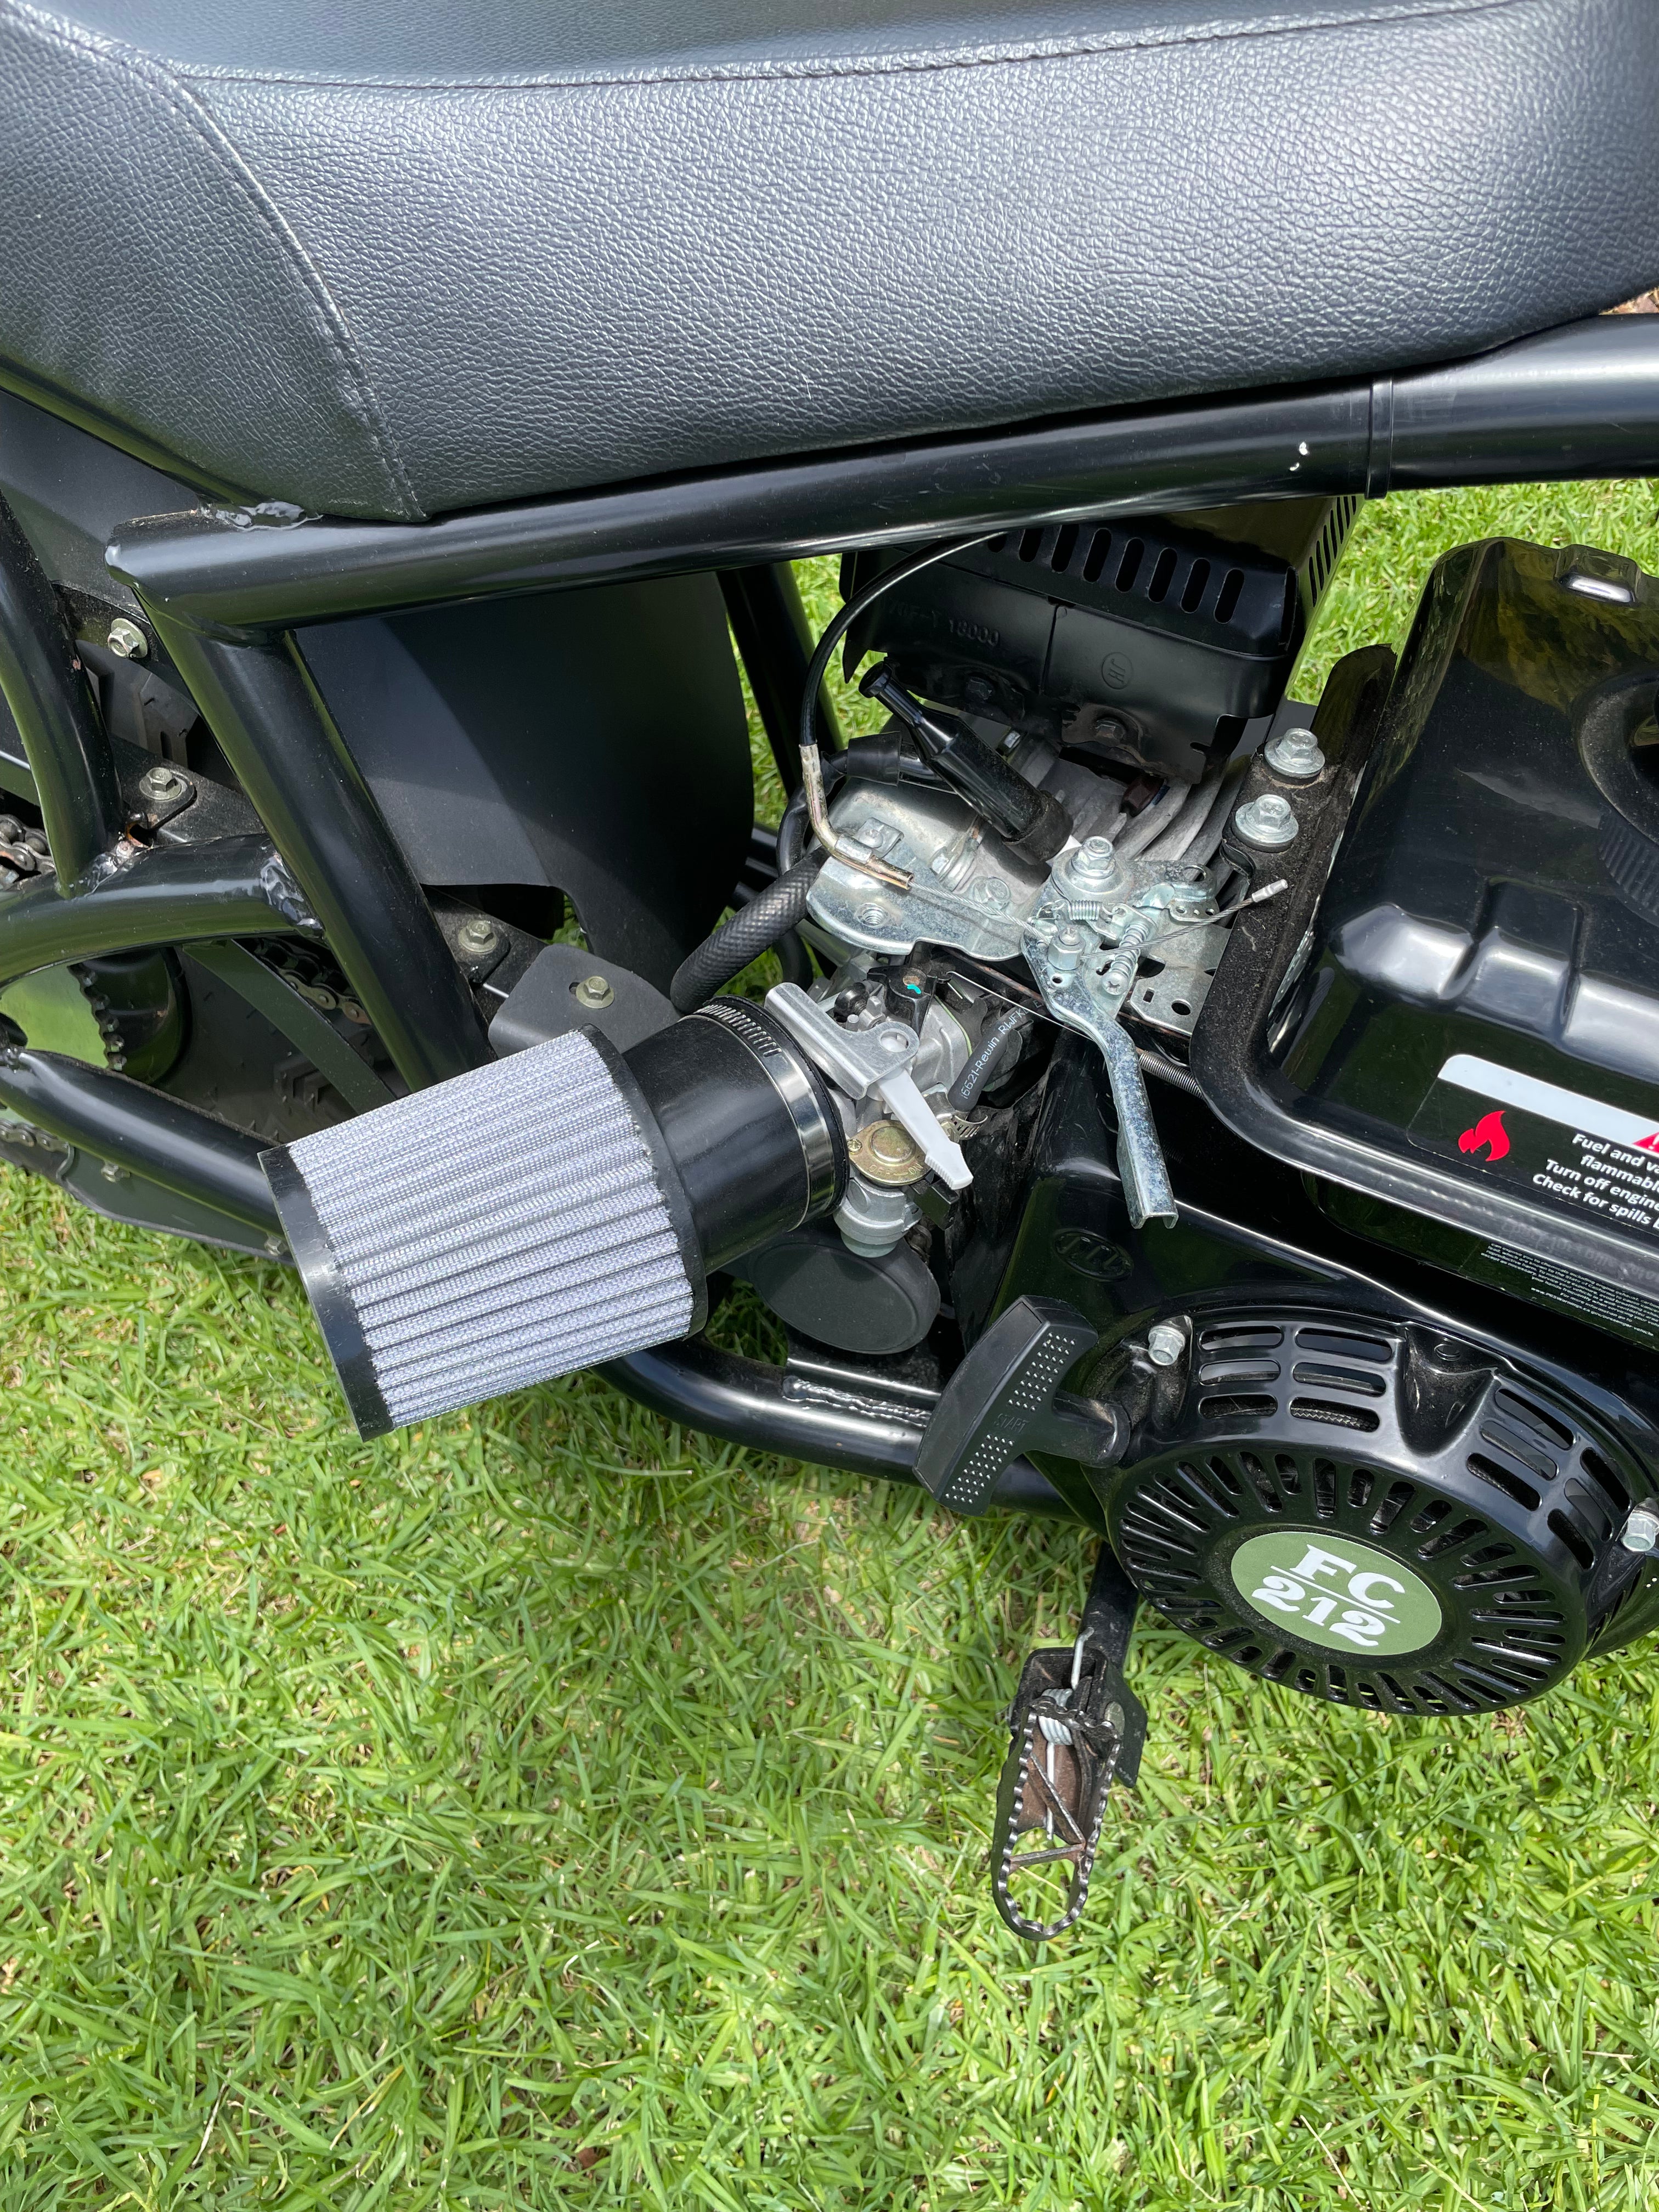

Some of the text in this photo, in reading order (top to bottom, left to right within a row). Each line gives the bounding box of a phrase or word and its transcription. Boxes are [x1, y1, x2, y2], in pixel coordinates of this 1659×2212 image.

[1572, 1133, 1611, 1154] Fuel
[1610, 1149, 1645, 1167] and
[1545, 1159, 1581, 1181] Turn
[1584, 1176, 1611, 1190] off
[1581, 1154, 1659, 1193] flammabl
[1532, 1173, 1582, 1199] Check
[1583, 1192, 1609, 1207] for
[1609, 1204, 1652, 1224] spills
[994, 1413, 1030, 1433] START
[1289, 1544, 1406, 1609] FC
[1251, 1575, 1385, 1646] 212
